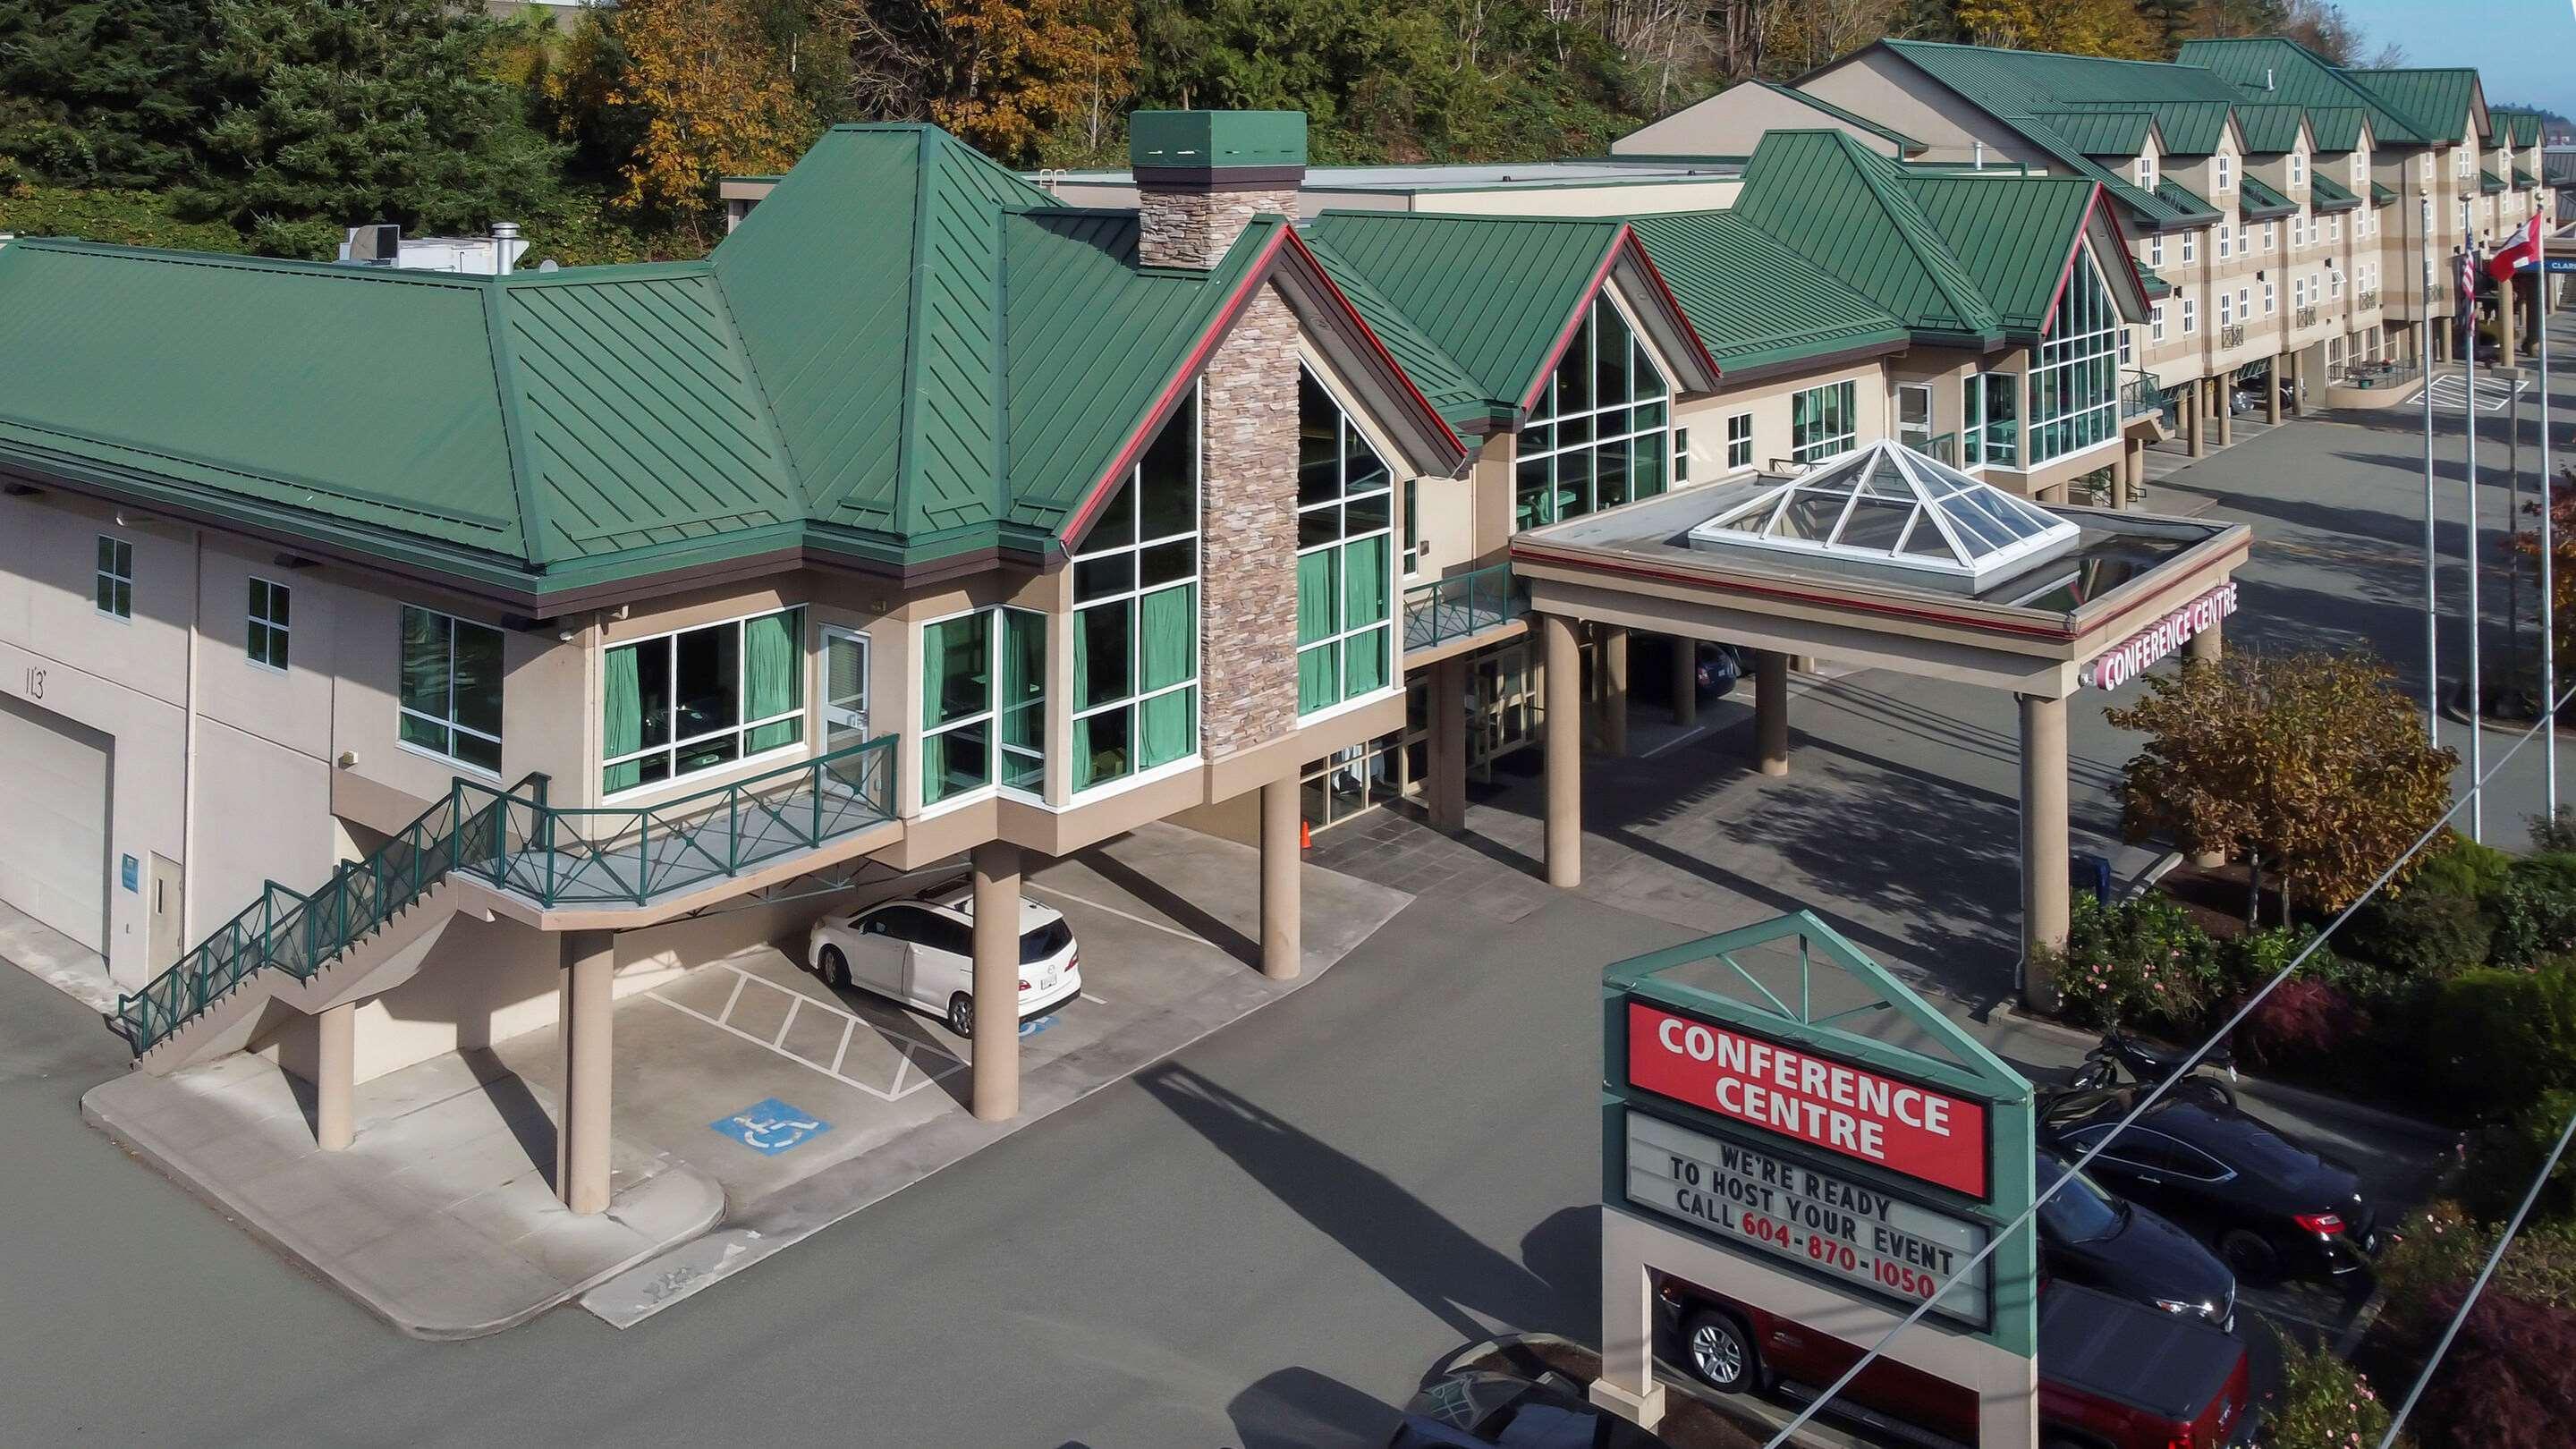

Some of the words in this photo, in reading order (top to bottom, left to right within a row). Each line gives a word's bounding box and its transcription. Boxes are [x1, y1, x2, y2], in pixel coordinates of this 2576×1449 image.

[2104, 610, 2191, 691] CONFERENCE
[2193, 582, 2238, 635] CENTRE
[1659, 1018, 1951, 1137] CONFERENCE
[1716, 1077, 1885, 1160] CENTRE
[1671, 1157, 1700, 1186] TO
[1713, 1170, 1775, 1212] HOST
[1785, 1196, 1857, 1243] YOUR
[1874, 1226, 1953, 1276] EVENT
[1677, 1189, 1735, 1230] CALL
[1721, 1145, 1794, 1191] WE'RE
[1805, 1173, 1892, 1223] READY
